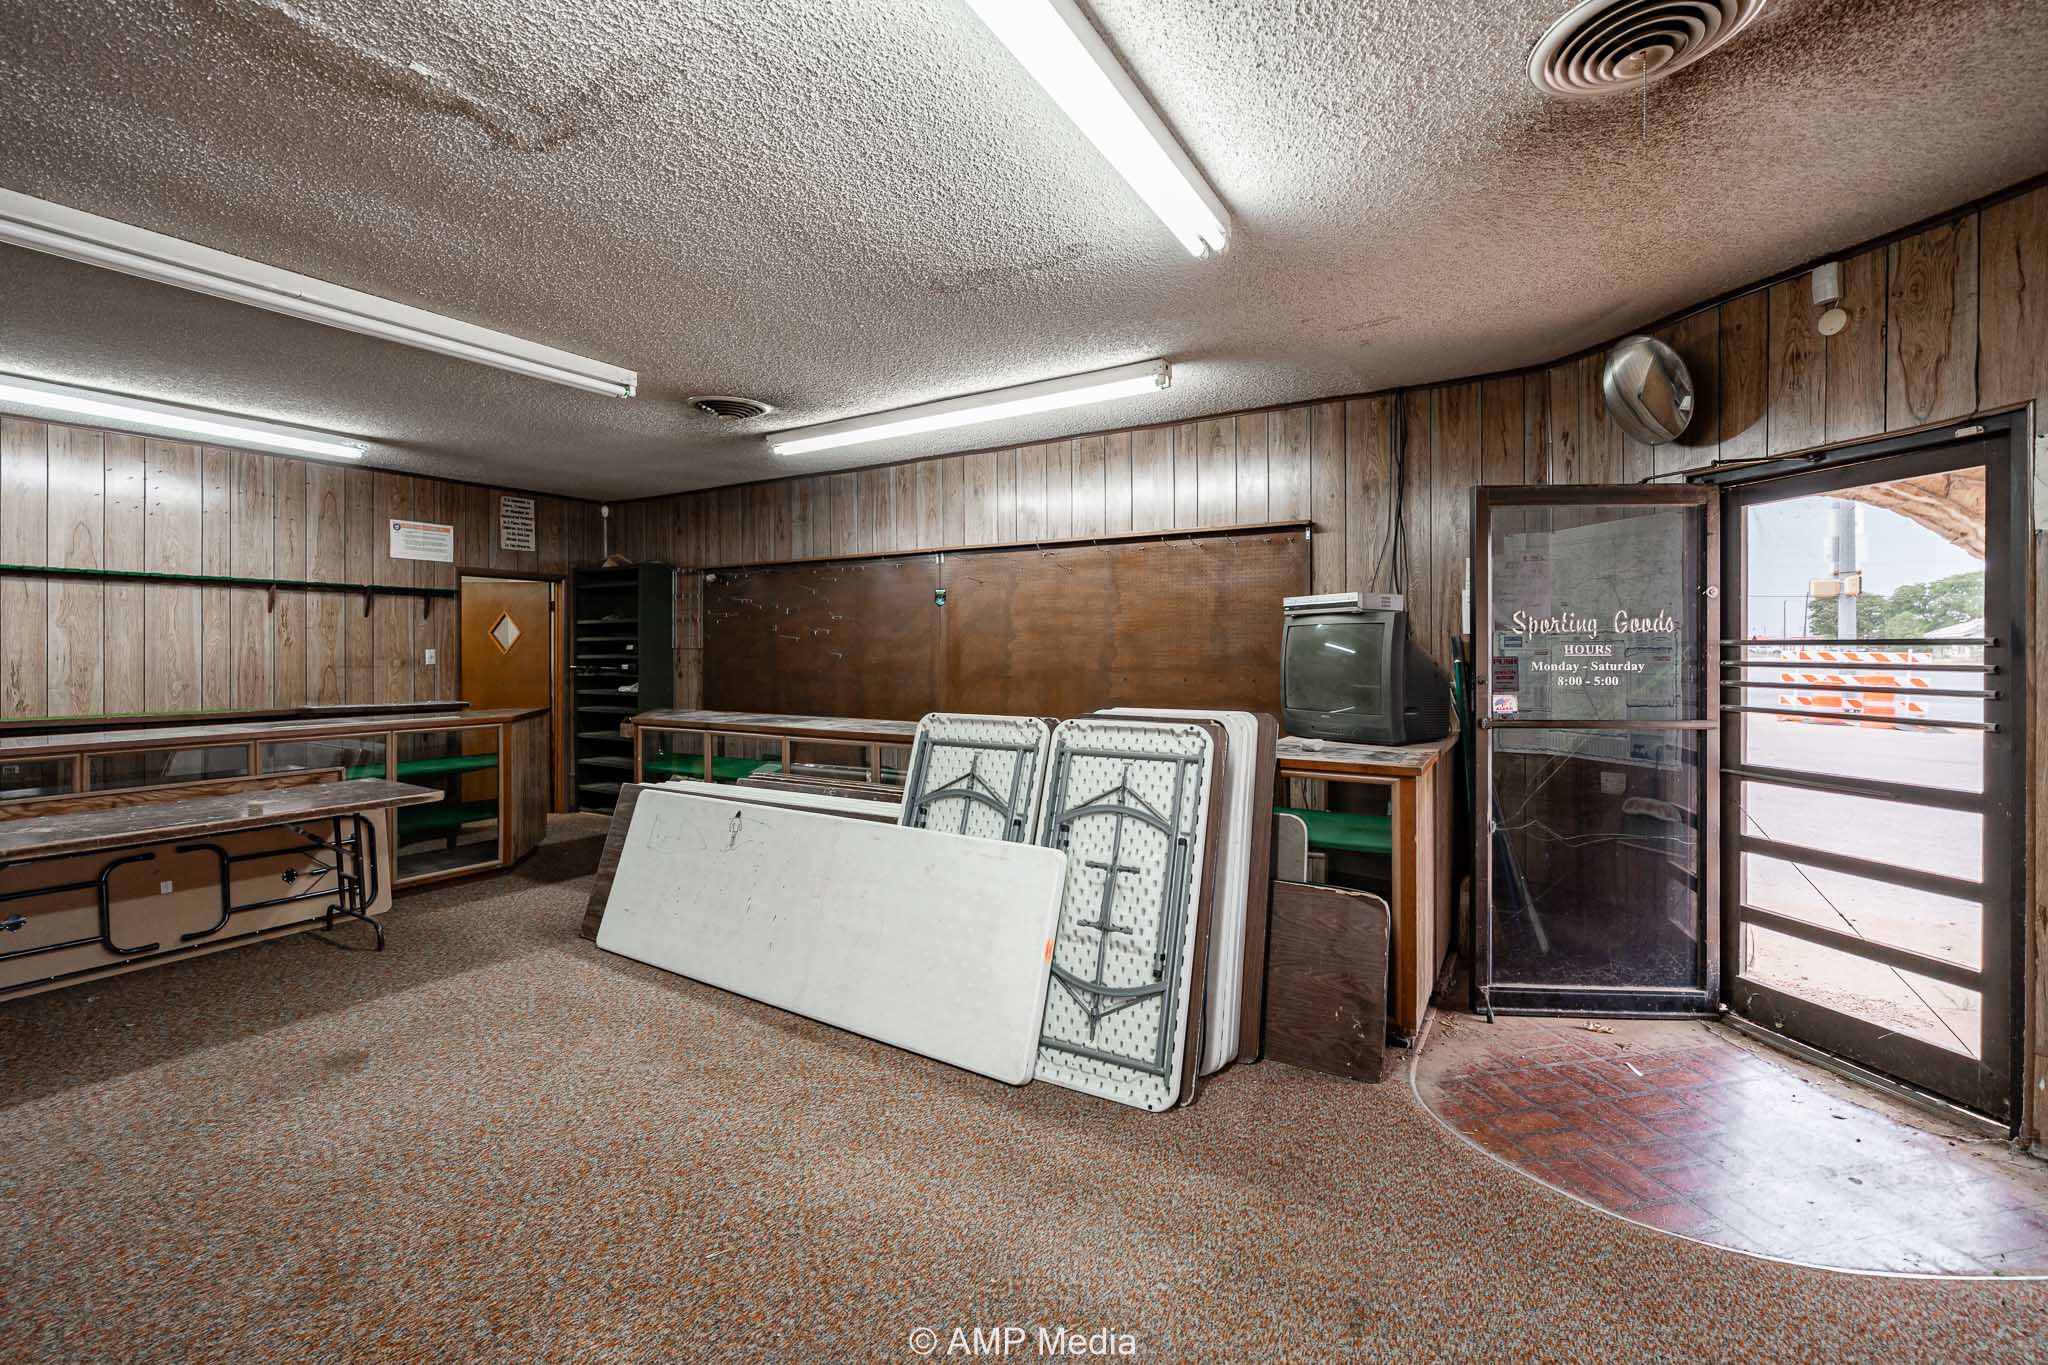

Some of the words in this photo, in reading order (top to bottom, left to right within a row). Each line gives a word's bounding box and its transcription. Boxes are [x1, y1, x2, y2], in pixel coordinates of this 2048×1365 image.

[1511, 609, 1598, 641] Sporting
[1614, 608, 1675, 634] Goods
[1563, 644, 1613, 657] HOURS
[1531, 660, 1580, 674] Monday
[1590, 660, 1646, 674] Saturday
[1556, 675, 1583, 686] 8:00
[1593, 675, 1619, 686] 5:00
